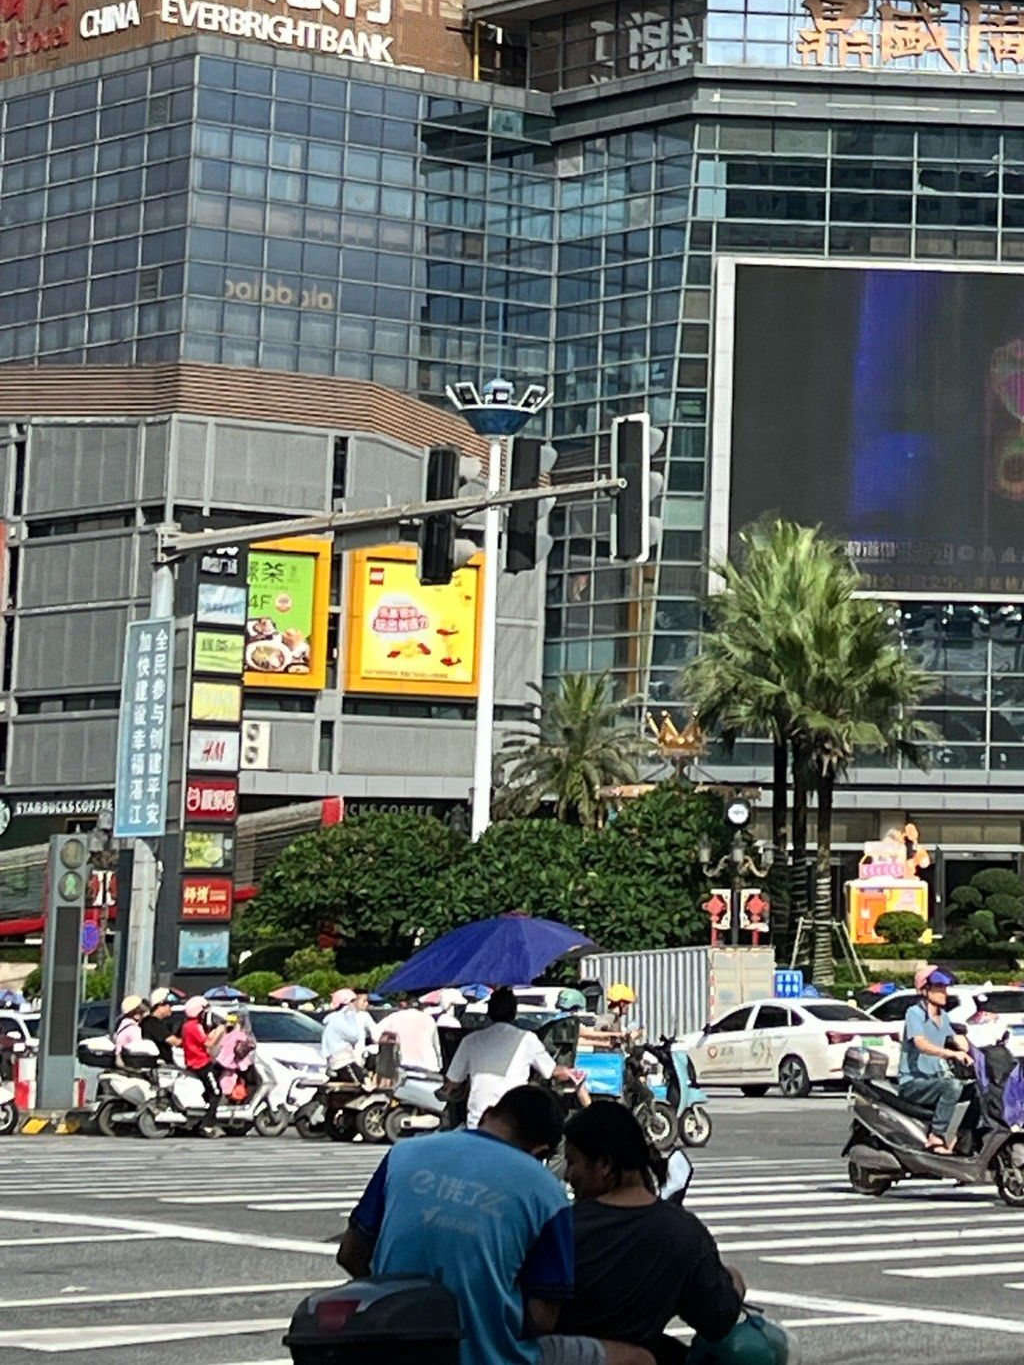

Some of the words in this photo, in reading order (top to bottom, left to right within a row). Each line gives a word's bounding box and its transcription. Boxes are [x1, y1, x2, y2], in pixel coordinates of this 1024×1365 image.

[80, 0, 140, 38] CHINA
[128, 630, 152, 825] 加快建设幸福湛江
[146, 628, 169, 825] 全民参与创建平安
[16, 801, 75, 815] STARBUCKS
